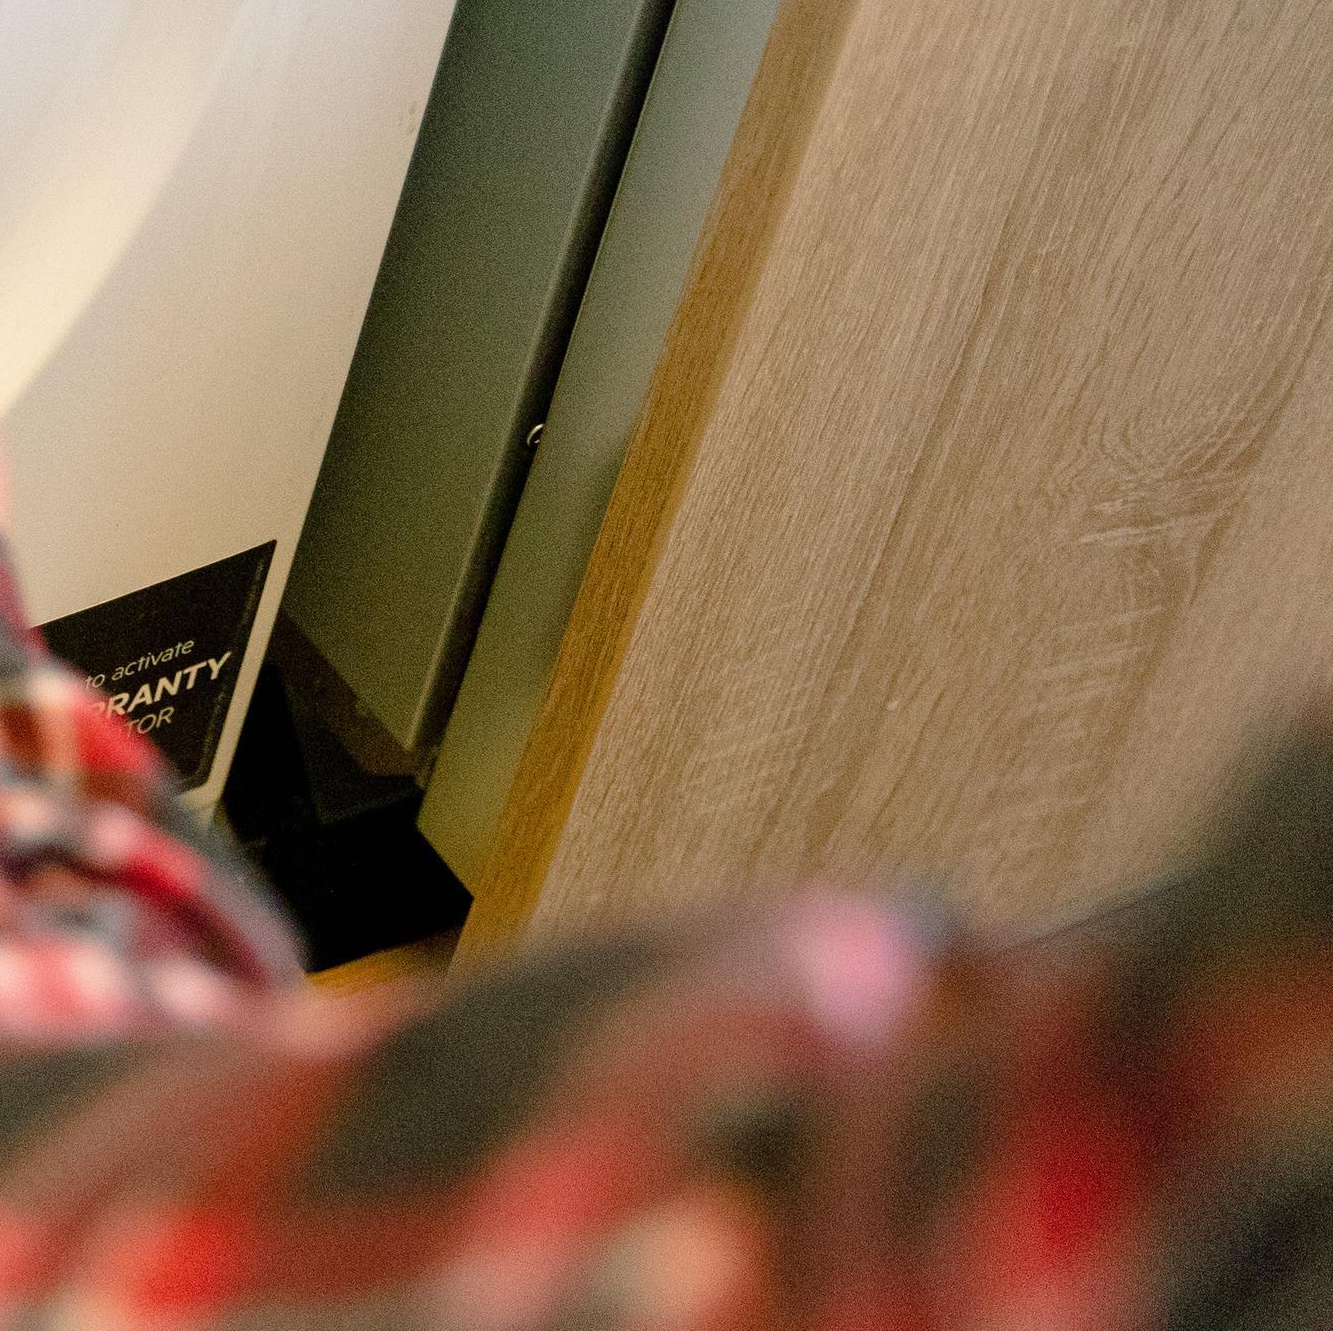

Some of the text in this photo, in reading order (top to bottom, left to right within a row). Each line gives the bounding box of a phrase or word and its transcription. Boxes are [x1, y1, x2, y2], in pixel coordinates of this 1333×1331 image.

[85, 640, 195, 689] to activate
[120, 706, 175, 737] TOR
